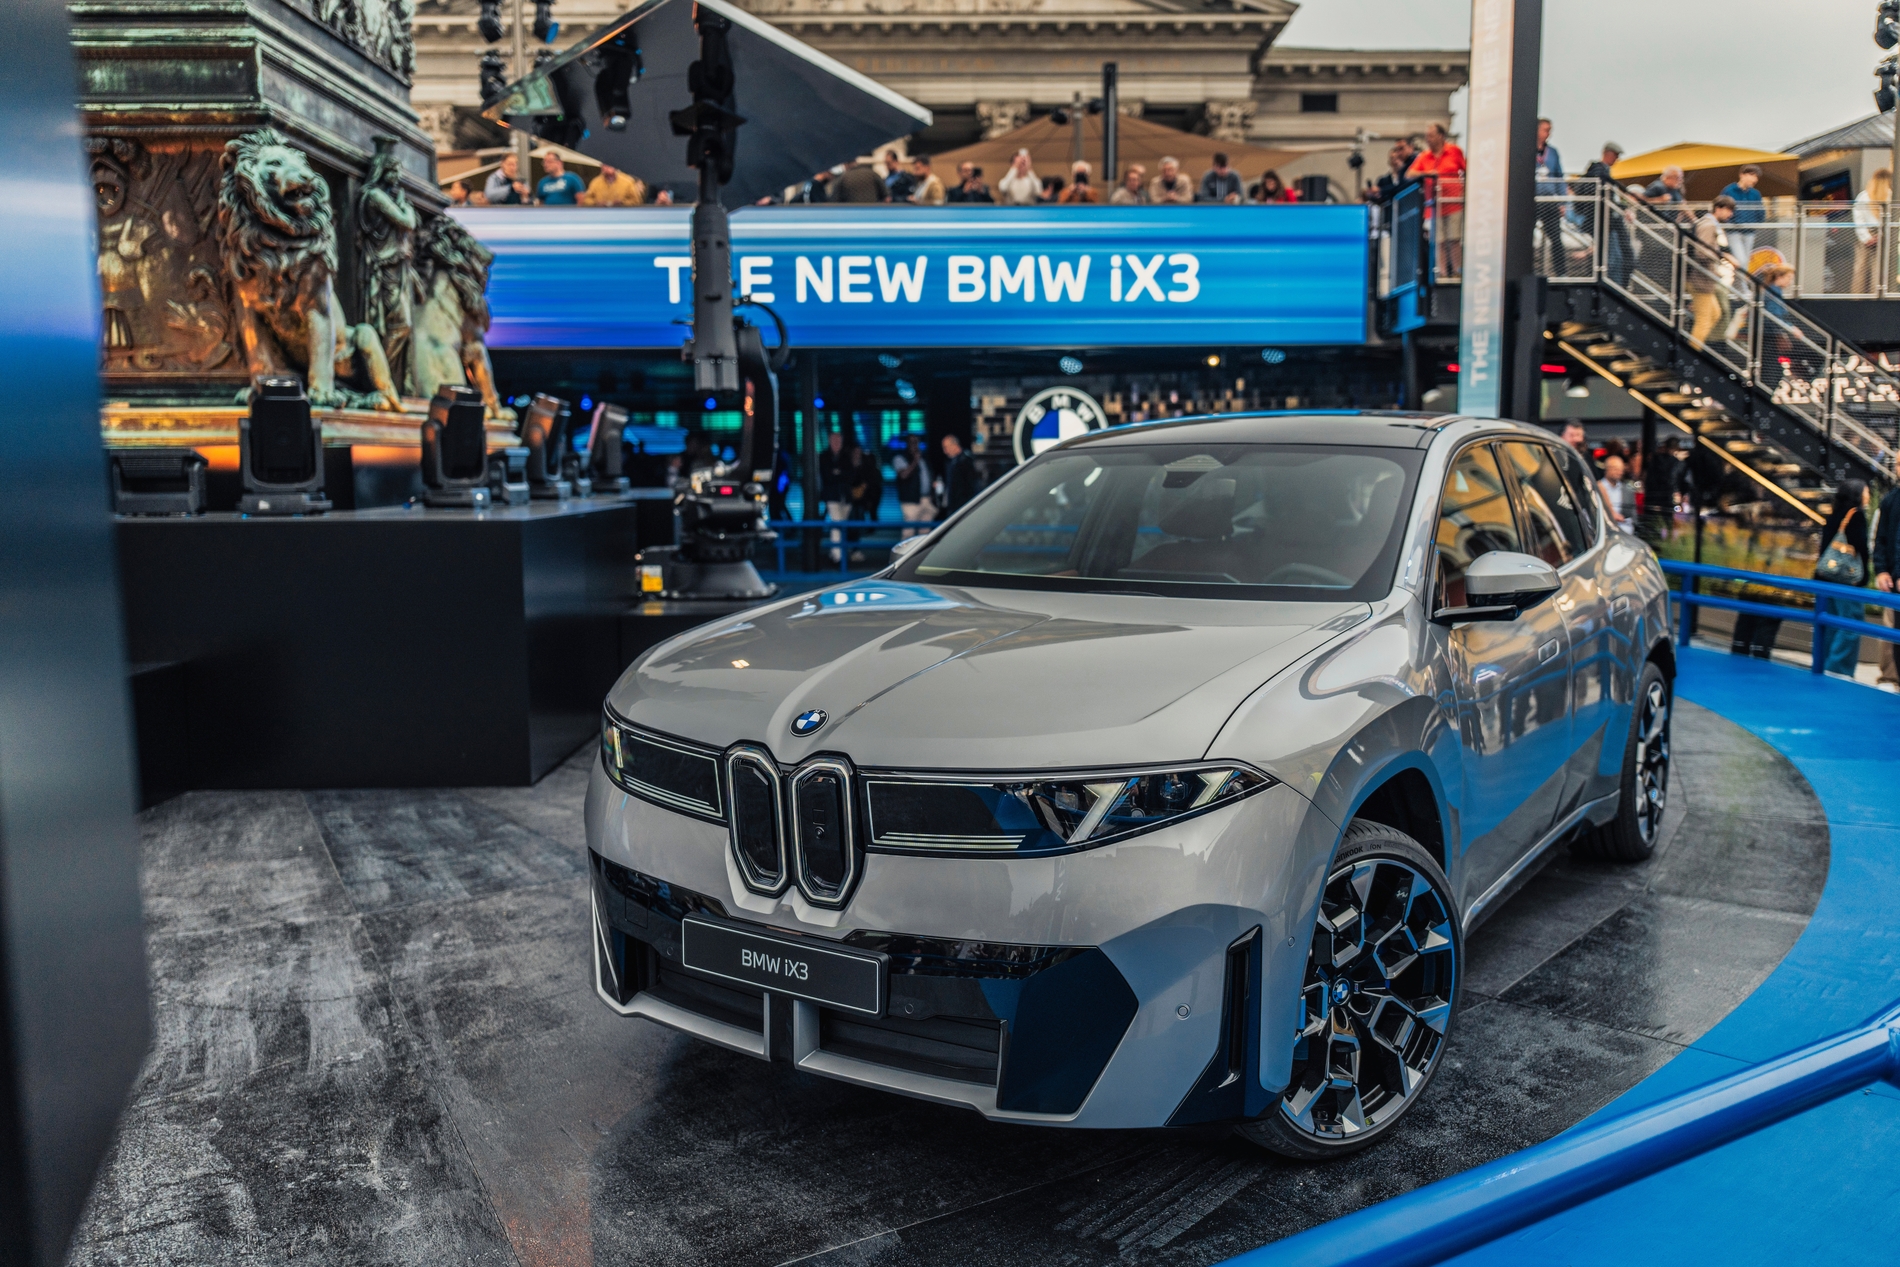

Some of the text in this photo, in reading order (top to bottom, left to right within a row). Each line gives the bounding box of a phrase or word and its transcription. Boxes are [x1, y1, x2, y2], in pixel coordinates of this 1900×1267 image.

[1482, 0, 1502, 44] NE
[1475, 188, 1494, 257] BMW
[653, 253, 1201, 304] TE NEW BMW iX3
[1473, 263, 1492, 326] NEW
[1470, 329, 1490, 388] THE
[1026, 394, 1096, 425] BMW
[741, 949, 809, 980] BMW iX3
